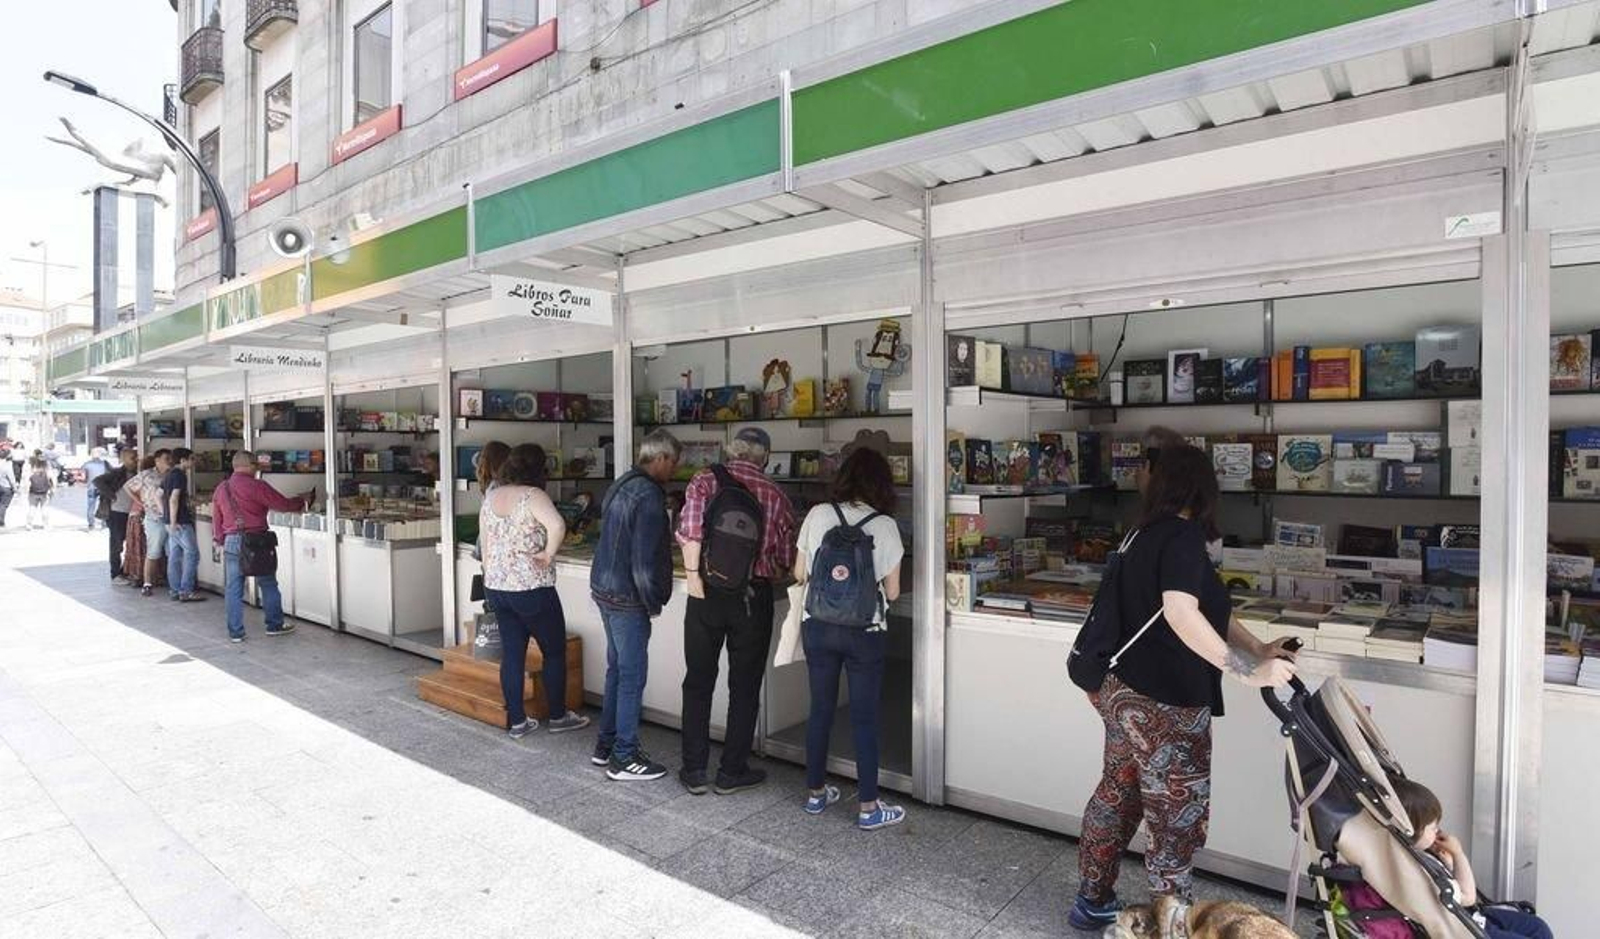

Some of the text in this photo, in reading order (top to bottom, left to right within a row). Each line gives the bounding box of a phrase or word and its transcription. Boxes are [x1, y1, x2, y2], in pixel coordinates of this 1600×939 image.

[507, 283, 591, 307] Libros Para
[530, 300, 573, 319] Soñar
